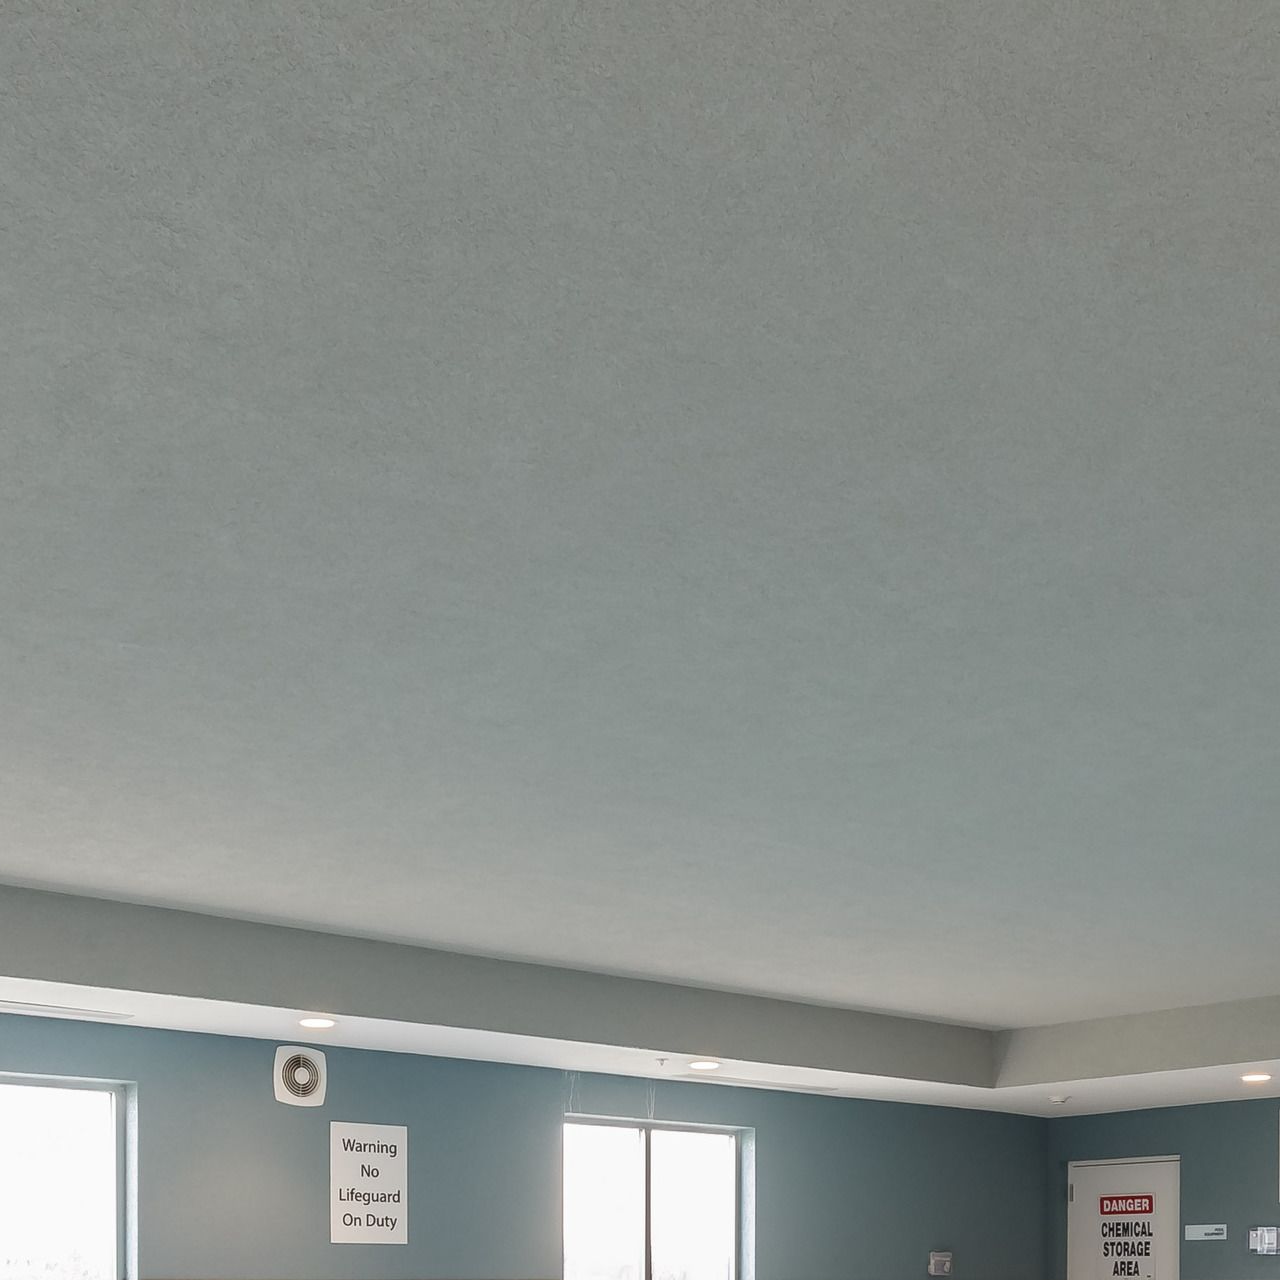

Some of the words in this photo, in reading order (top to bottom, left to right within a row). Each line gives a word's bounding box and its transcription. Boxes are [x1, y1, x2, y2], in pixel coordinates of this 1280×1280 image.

[342, 1138, 397, 1158] Warning
[360, 1164, 380, 1178] No
[339, 1187, 401, 1205] Lifeguard
[1103, 1199, 1150, 1212] DANGER
[342, 1213, 362, 1226] On
[366, 1213, 398, 1231] Duty
[1101, 1222, 1153, 1238] CHEMICAL
[1103, 1241, 1150, 1257] STORAGE
[1112, 1261, 1140, 1276] AREA
